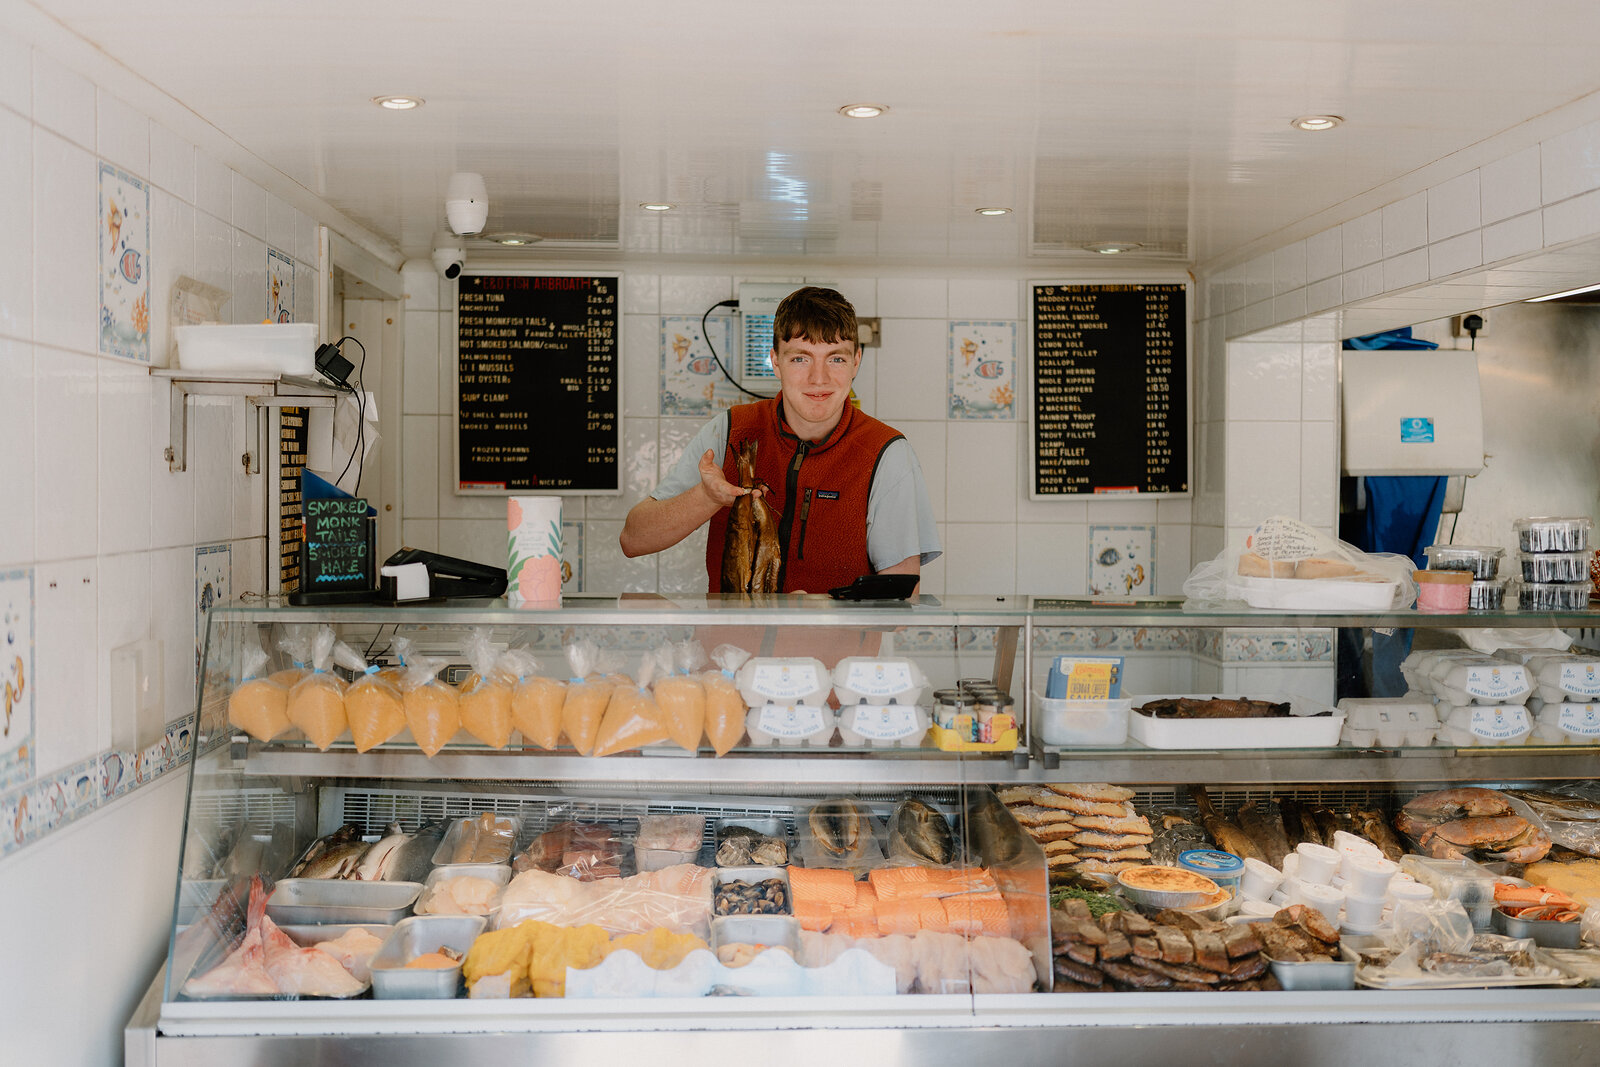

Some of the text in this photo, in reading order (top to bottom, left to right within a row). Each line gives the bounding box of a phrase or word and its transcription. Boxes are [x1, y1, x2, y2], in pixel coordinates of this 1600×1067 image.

[460, 294, 504, 302] FRESH TUNA
[460, 317, 546, 325] FRESH MONKFISH TAILS
[460, 329, 484, 337] FRESH
[485, 329, 516, 337] SALMON
[525, 329, 554, 338] FARMED
[460, 375, 475, 383] LIVE
[1060, 448, 1085, 456] FILLET
[308, 500, 367, 516] SMOKED
[317, 517, 360, 529] MONK
[309, 545, 367, 561] SMOKED
[1471, 687, 1488, 696] FRESH
[1510, 686, 1524, 695] EGGS
[1565, 683, 1582, 692] FRESH
[763, 724, 781, 734] FRESH
[1474, 727, 1491, 736] FRESH
[1511, 726, 1525, 735] EGGS
[1563, 723, 1580, 732] FRESH
